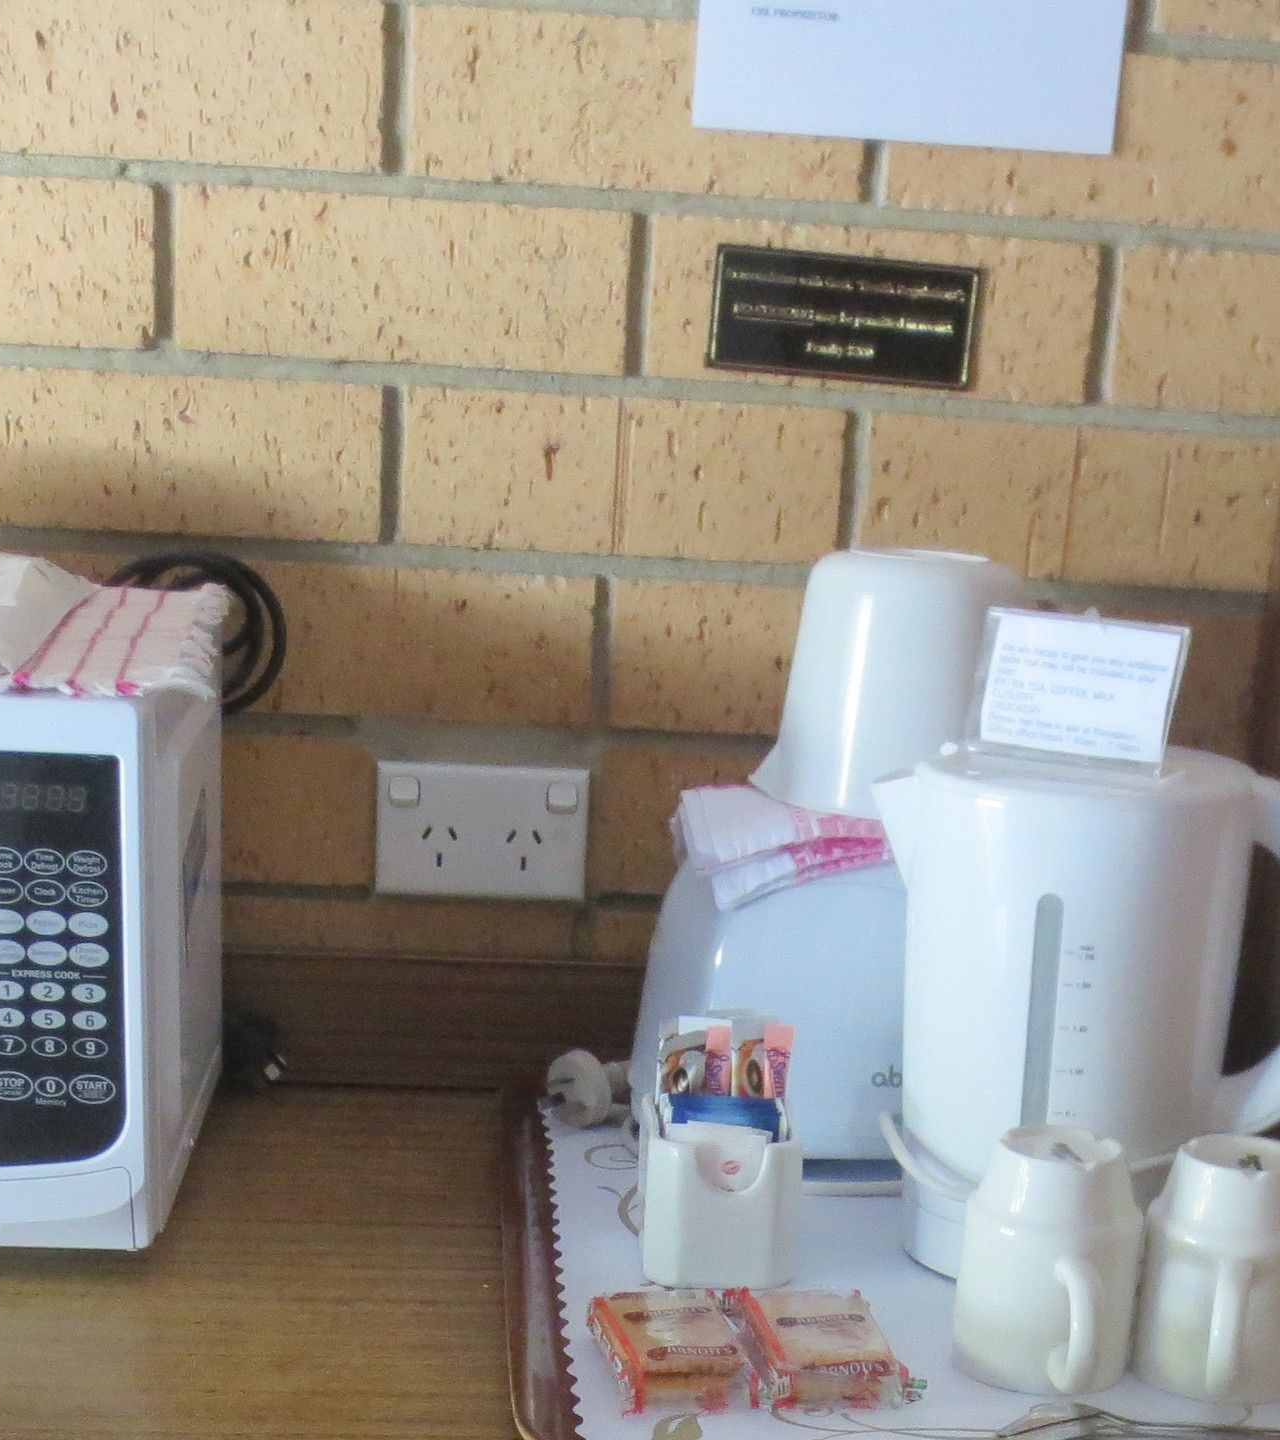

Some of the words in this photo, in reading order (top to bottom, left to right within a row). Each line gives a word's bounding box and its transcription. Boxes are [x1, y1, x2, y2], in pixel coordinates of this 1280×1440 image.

[34, 852, 54, 861] Time
[31, 861, 59, 871] Defrost
[33, 887, 56, 896] Clock
[71, 886, 103, 896] Kitchen
[75, 895, 100, 904] Timer
[10, 969, 53, 978] EXPRESS
[54, 971, 82, 980] COOK
[3, 984, 11, 997] 1
[43, 985, 53, 999] 2
[84, 987, 94, 1000] 3
[2, 1011, 13, 1024] 4
[43, 1013, 53, 1026] 5
[85, 1014, 95, 1027] 6
[4, 1038, 14, 1052] 7
[44, 1039, 55, 1053] 8
[85, 1041, 95, 1055] 9
[45, 1080, 56, 1093] 0
[76, 1081, 108, 1092] START
